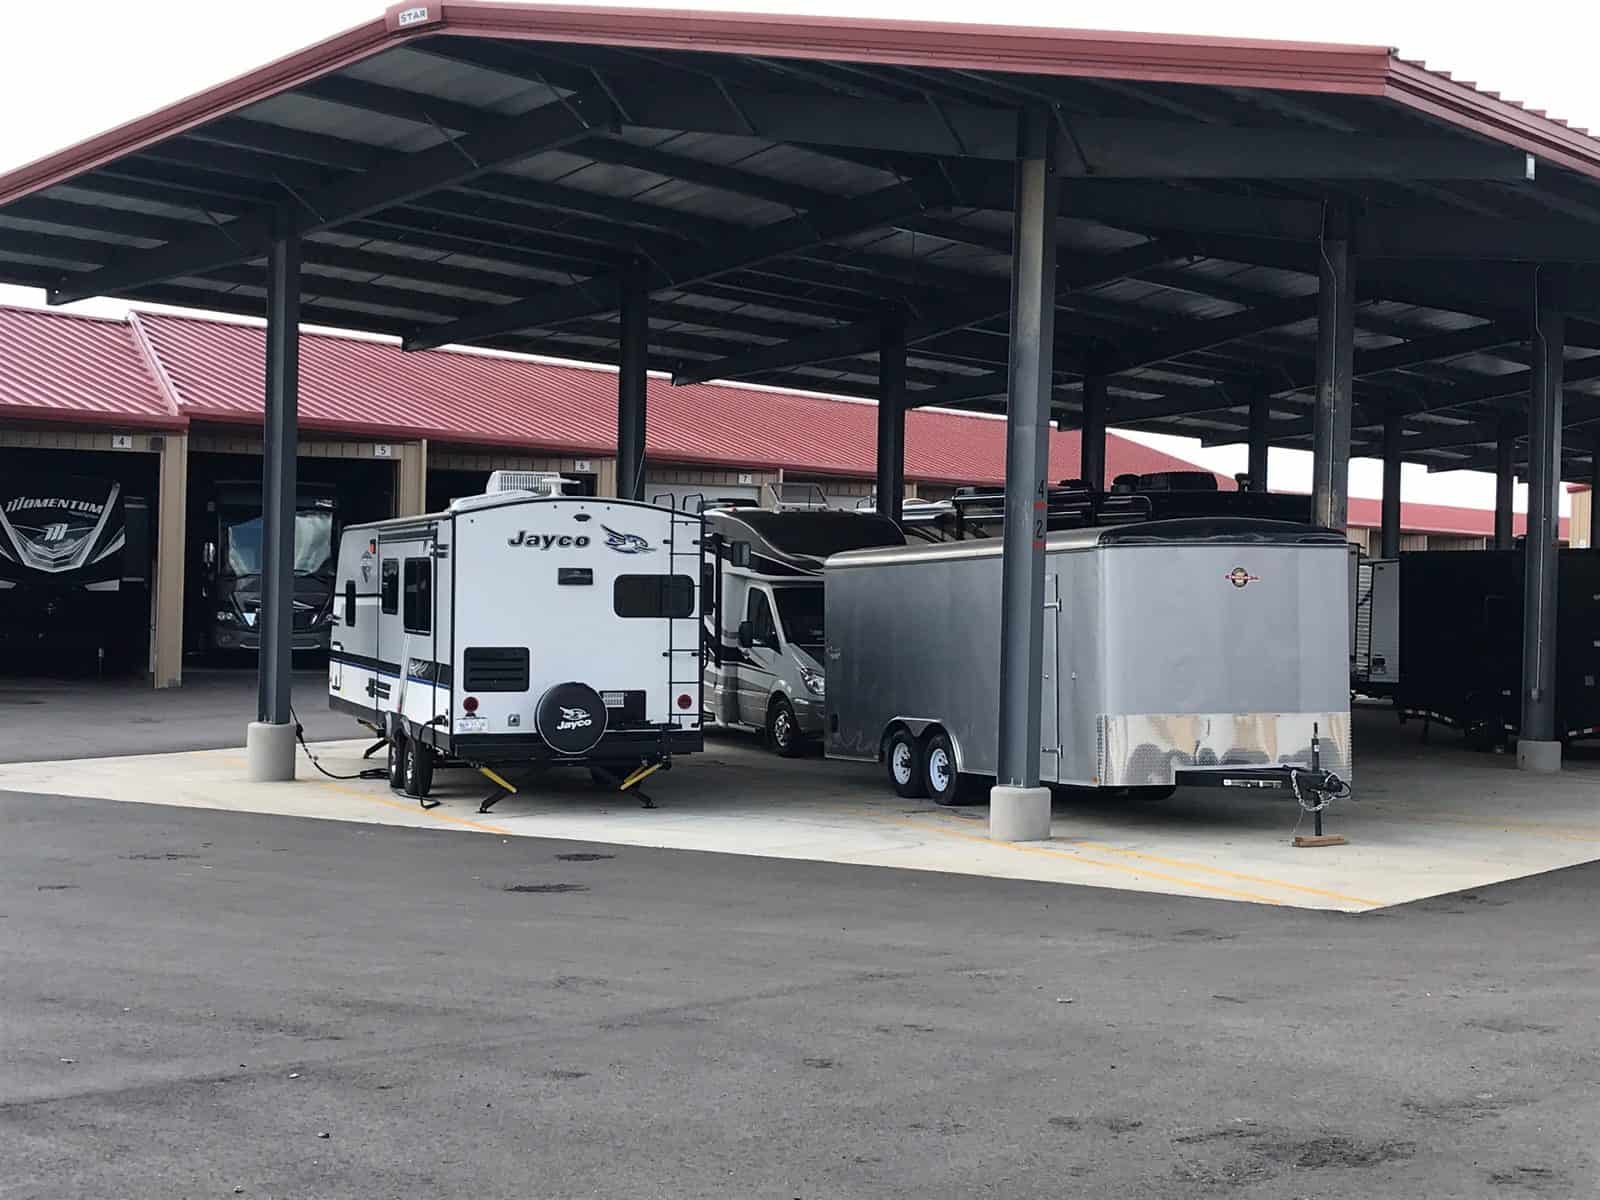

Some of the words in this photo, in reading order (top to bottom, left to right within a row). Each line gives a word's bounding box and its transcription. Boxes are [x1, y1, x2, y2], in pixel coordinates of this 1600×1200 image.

[400, 9, 426, 23] STAR
[1038, 479, 1045, 498] 4
[5, 496, 104, 514] MOMENTUM
[1036, 519, 1043, 538] 2
[508, 530, 590, 551] Jayco
[556, 719, 592, 730] Jayco
